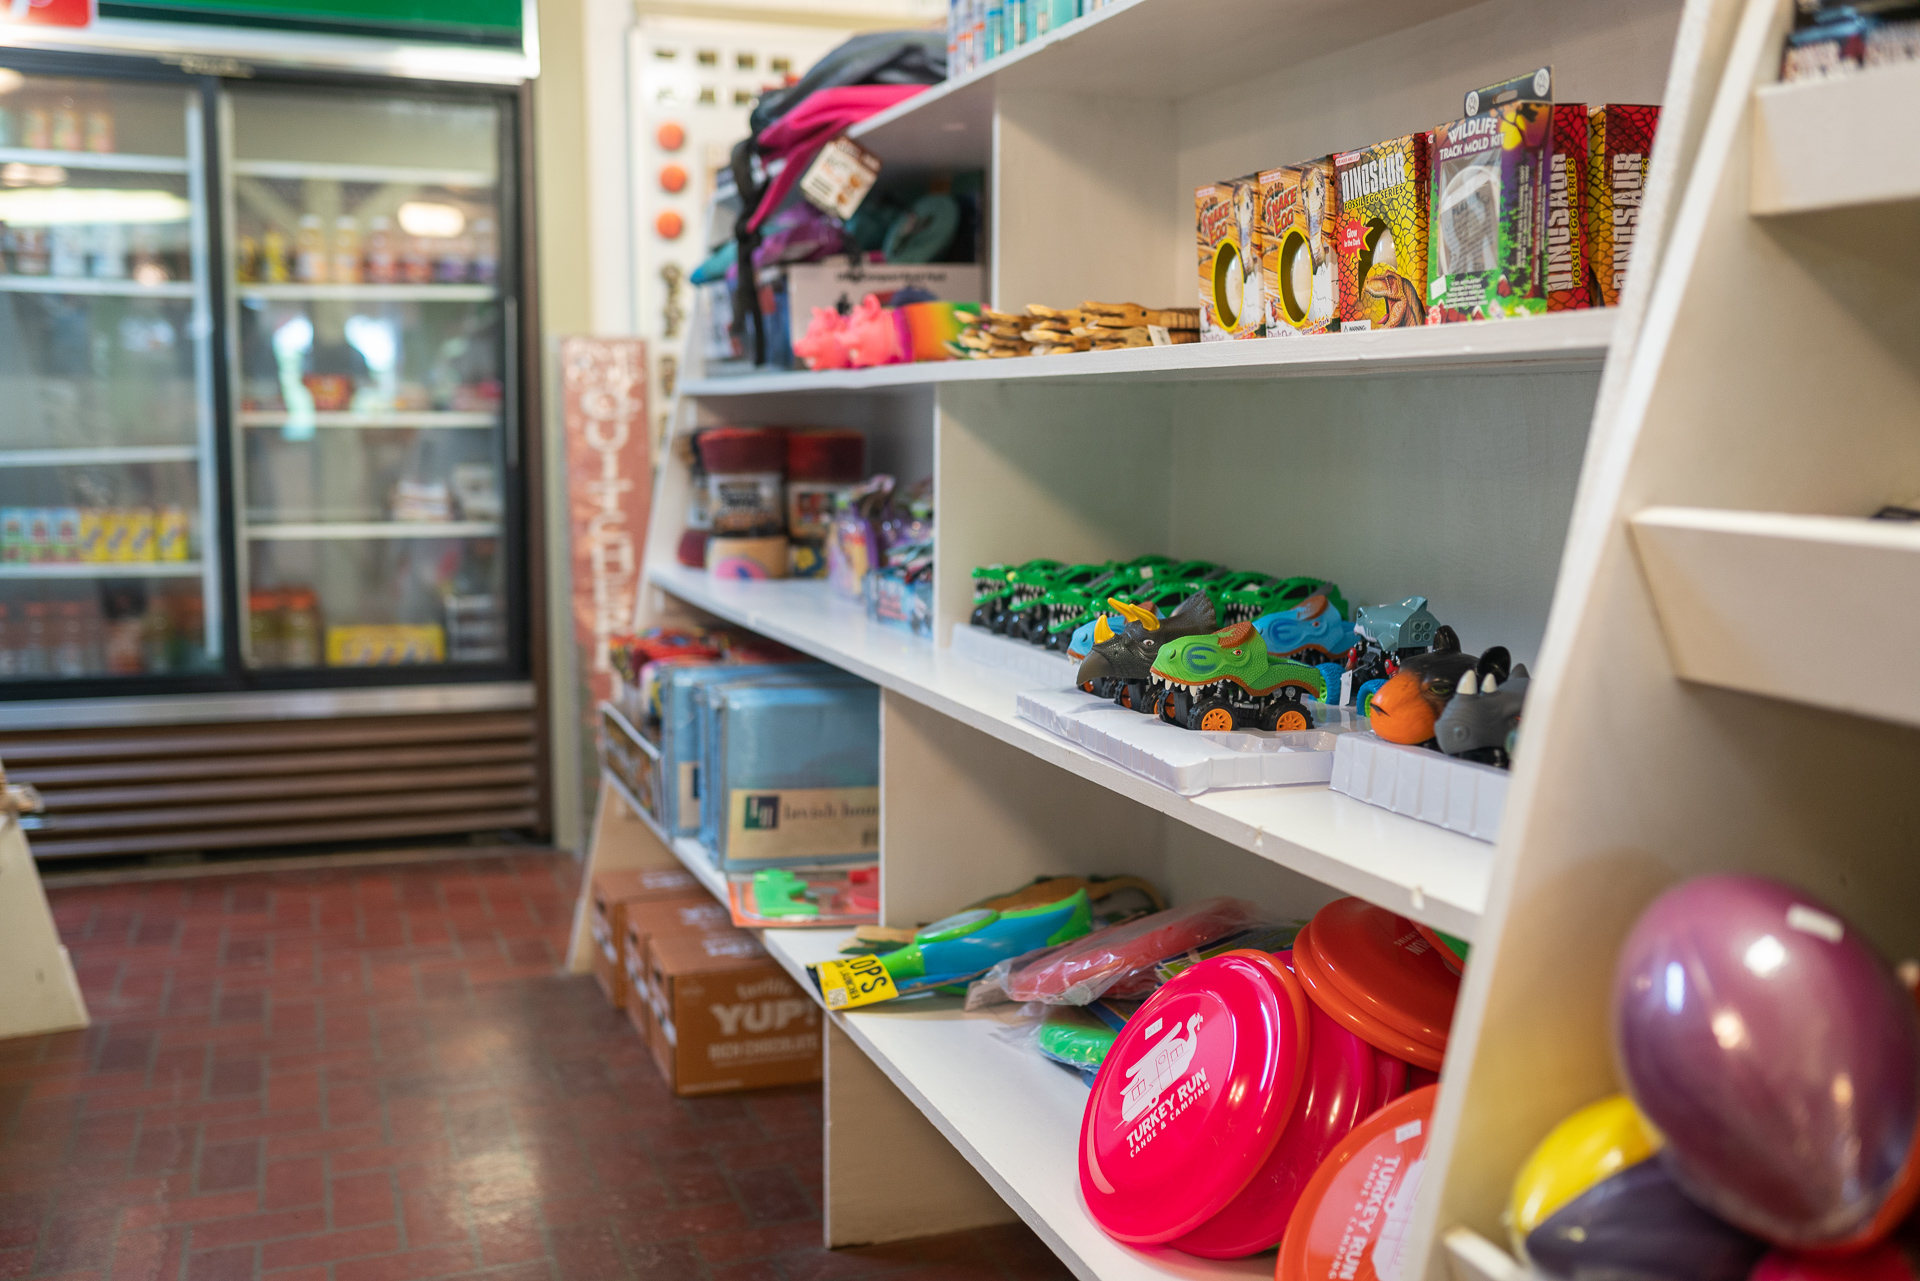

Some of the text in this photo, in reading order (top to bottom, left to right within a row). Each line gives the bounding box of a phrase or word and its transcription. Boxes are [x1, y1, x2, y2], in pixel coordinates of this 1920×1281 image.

[1439, 132, 1506, 161] TRACK MOLD KIT
[1448, 117, 1498, 144] WILDLIFE
[1341, 152, 1406, 203] DINOSAUR
[1266, 186, 1298, 226] SNAKE
[1344, 185, 1403, 211] FOSSIL EGG SERIES
[1274, 208, 1294, 237] EGG
[1346, 228, 1358, 239] Glow
[1566, 158, 1582, 287] FOSSIL EGG SERIES
[709, 999, 817, 1036] YUP!
[1126, 1067, 1207, 1148] TURKEY RUN
[1130, 1081, 1211, 1158] CANOE & CAMPING
[1360, 1154, 1383, 1197] CANOE
[1338, 1155, 1401, 1281] TURKEY RUN
